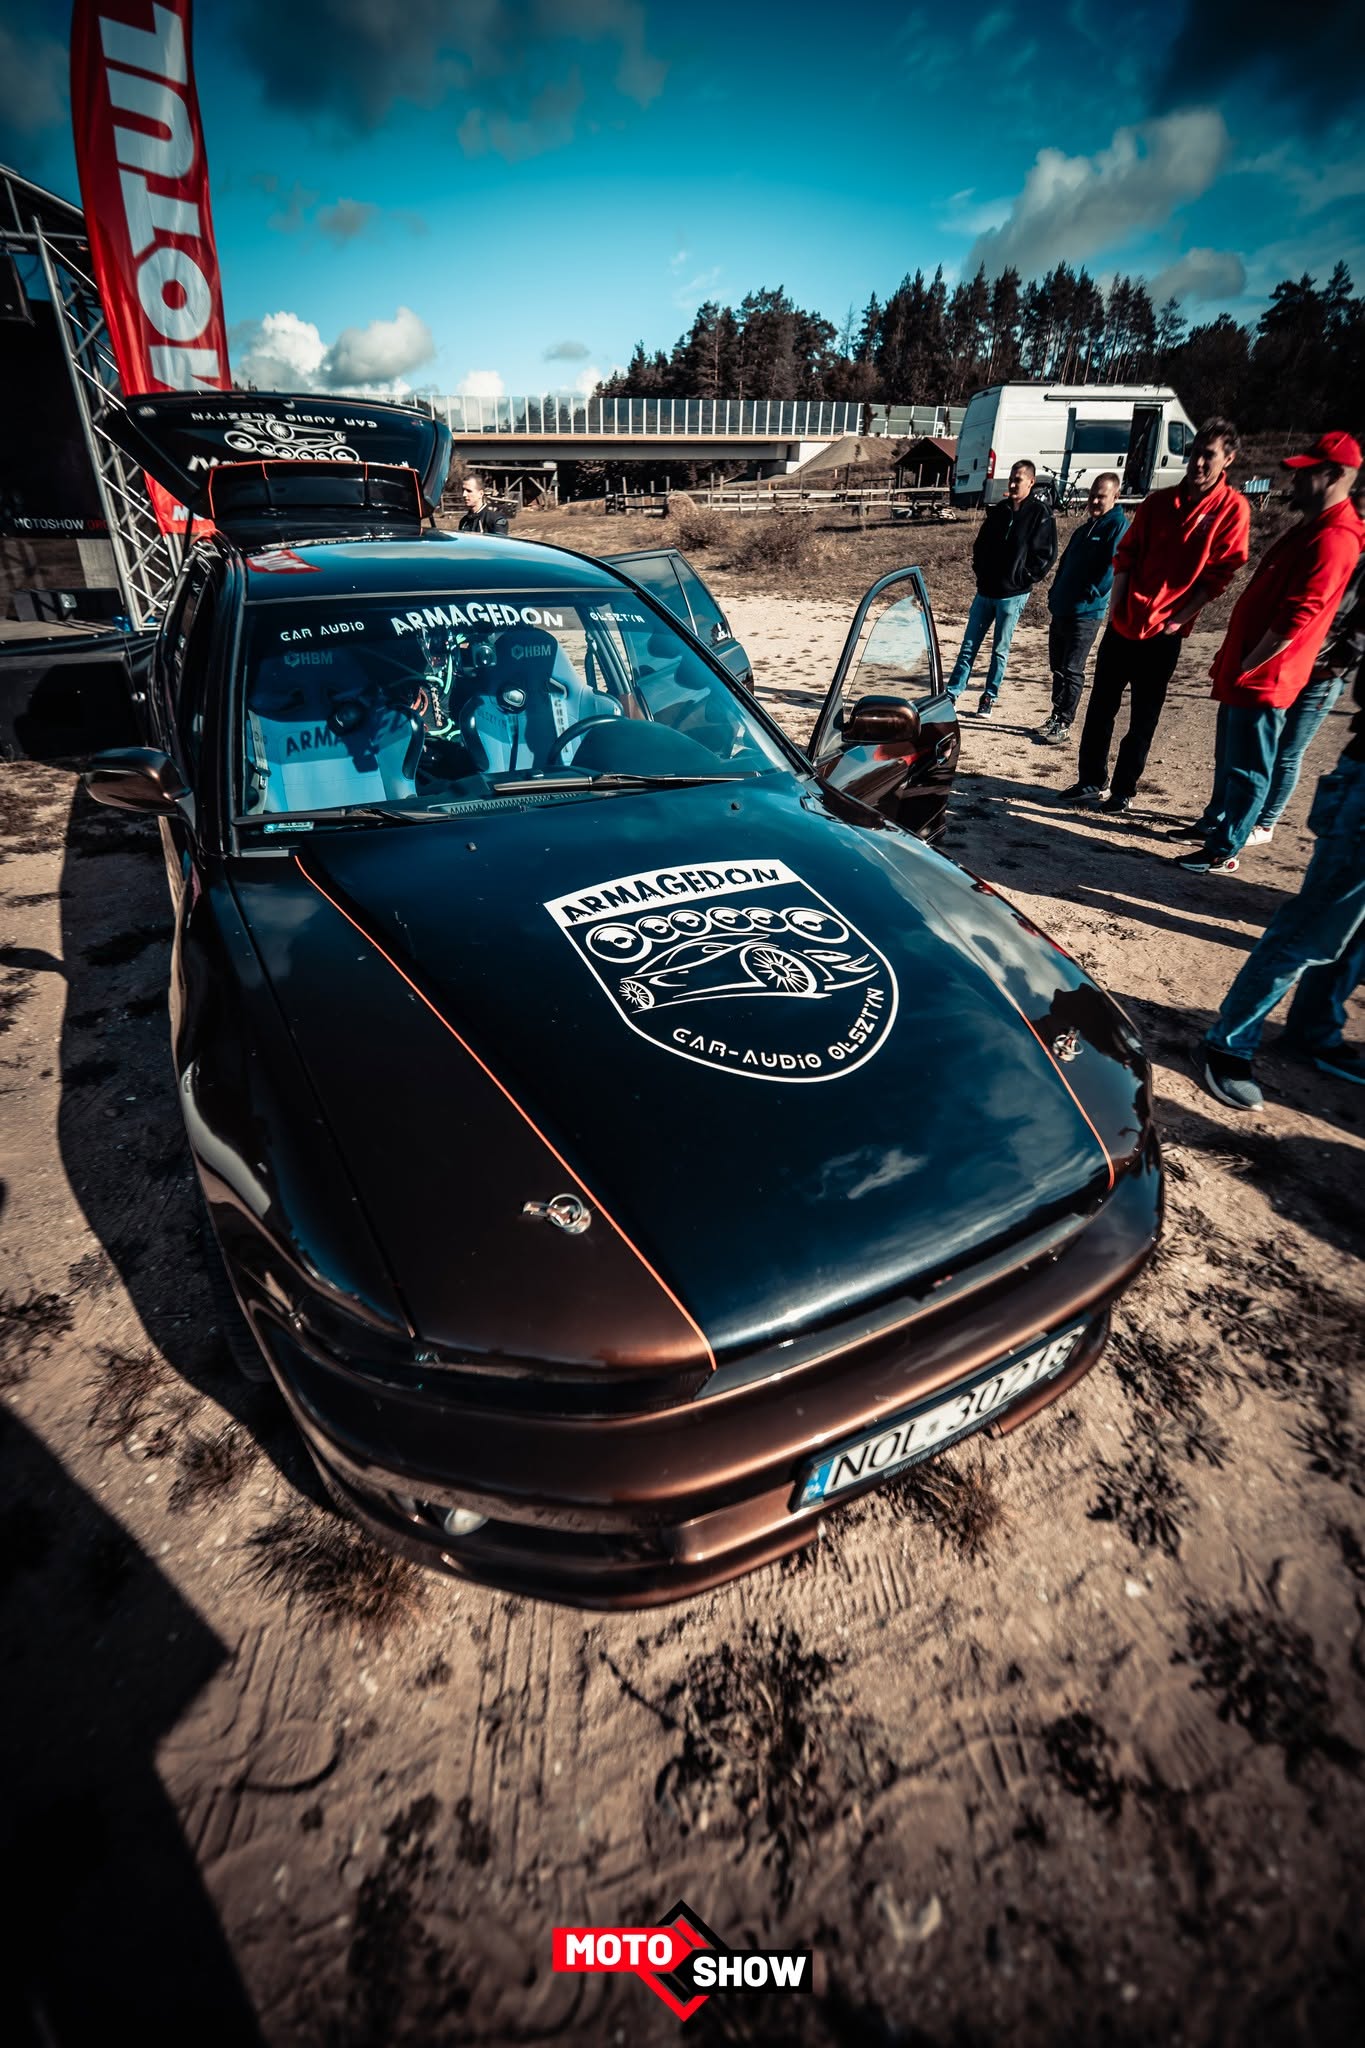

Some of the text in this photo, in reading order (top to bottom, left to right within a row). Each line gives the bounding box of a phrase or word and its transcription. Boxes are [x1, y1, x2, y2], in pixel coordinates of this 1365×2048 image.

[14, 517, 84, 530] MOTOSHOW
[280, 627, 313, 642] CAR
[390, 602, 563, 637] ARMAGEDON
[301, 651, 333, 665] HBM
[525, 645, 551, 657] HBM
[561, 868, 780, 924] ARMAGEDON
[828, 987, 885, 1060] OLSZTYN
[832, 1422, 926, 1489] NOL
